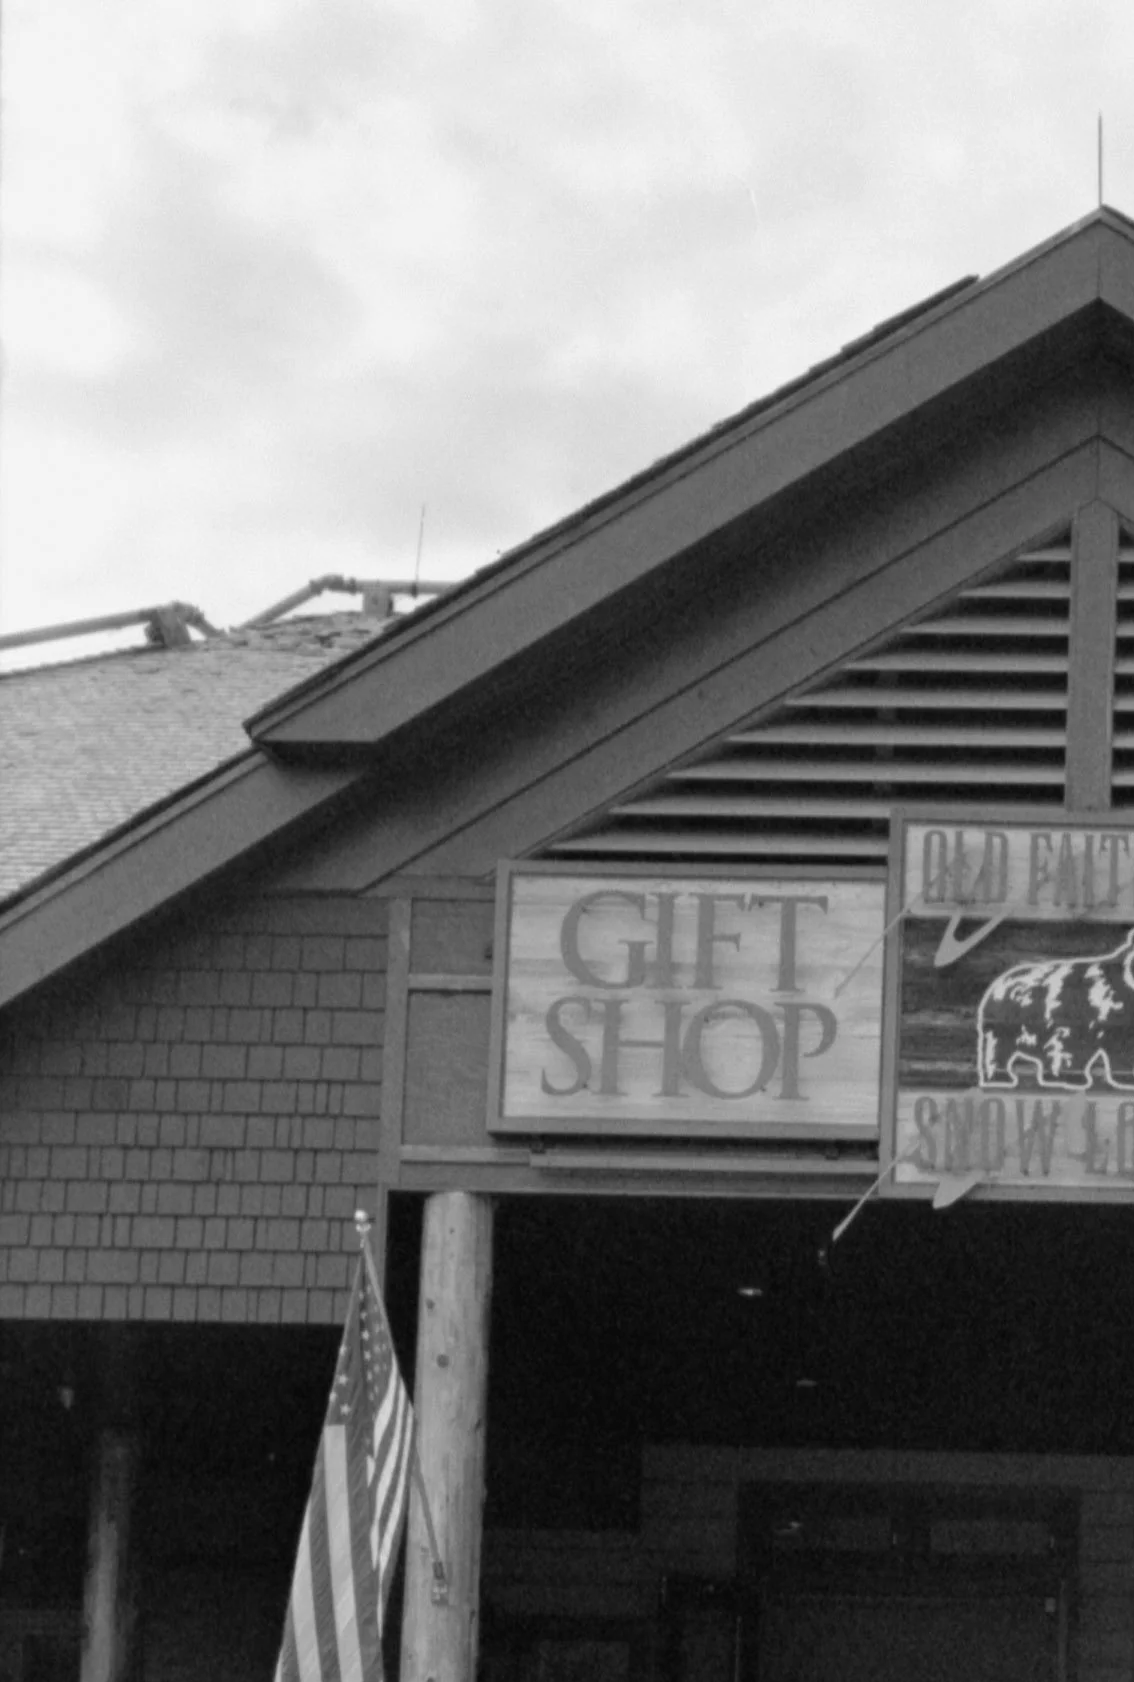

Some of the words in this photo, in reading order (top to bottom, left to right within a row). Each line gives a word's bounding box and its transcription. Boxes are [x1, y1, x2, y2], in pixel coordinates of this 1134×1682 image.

[922, 829, 1009, 906] OLD
[560, 889, 829, 993] GIFT
[540, 995, 838, 1101] SHOP
[913, 1096, 1060, 1177] SNOW
